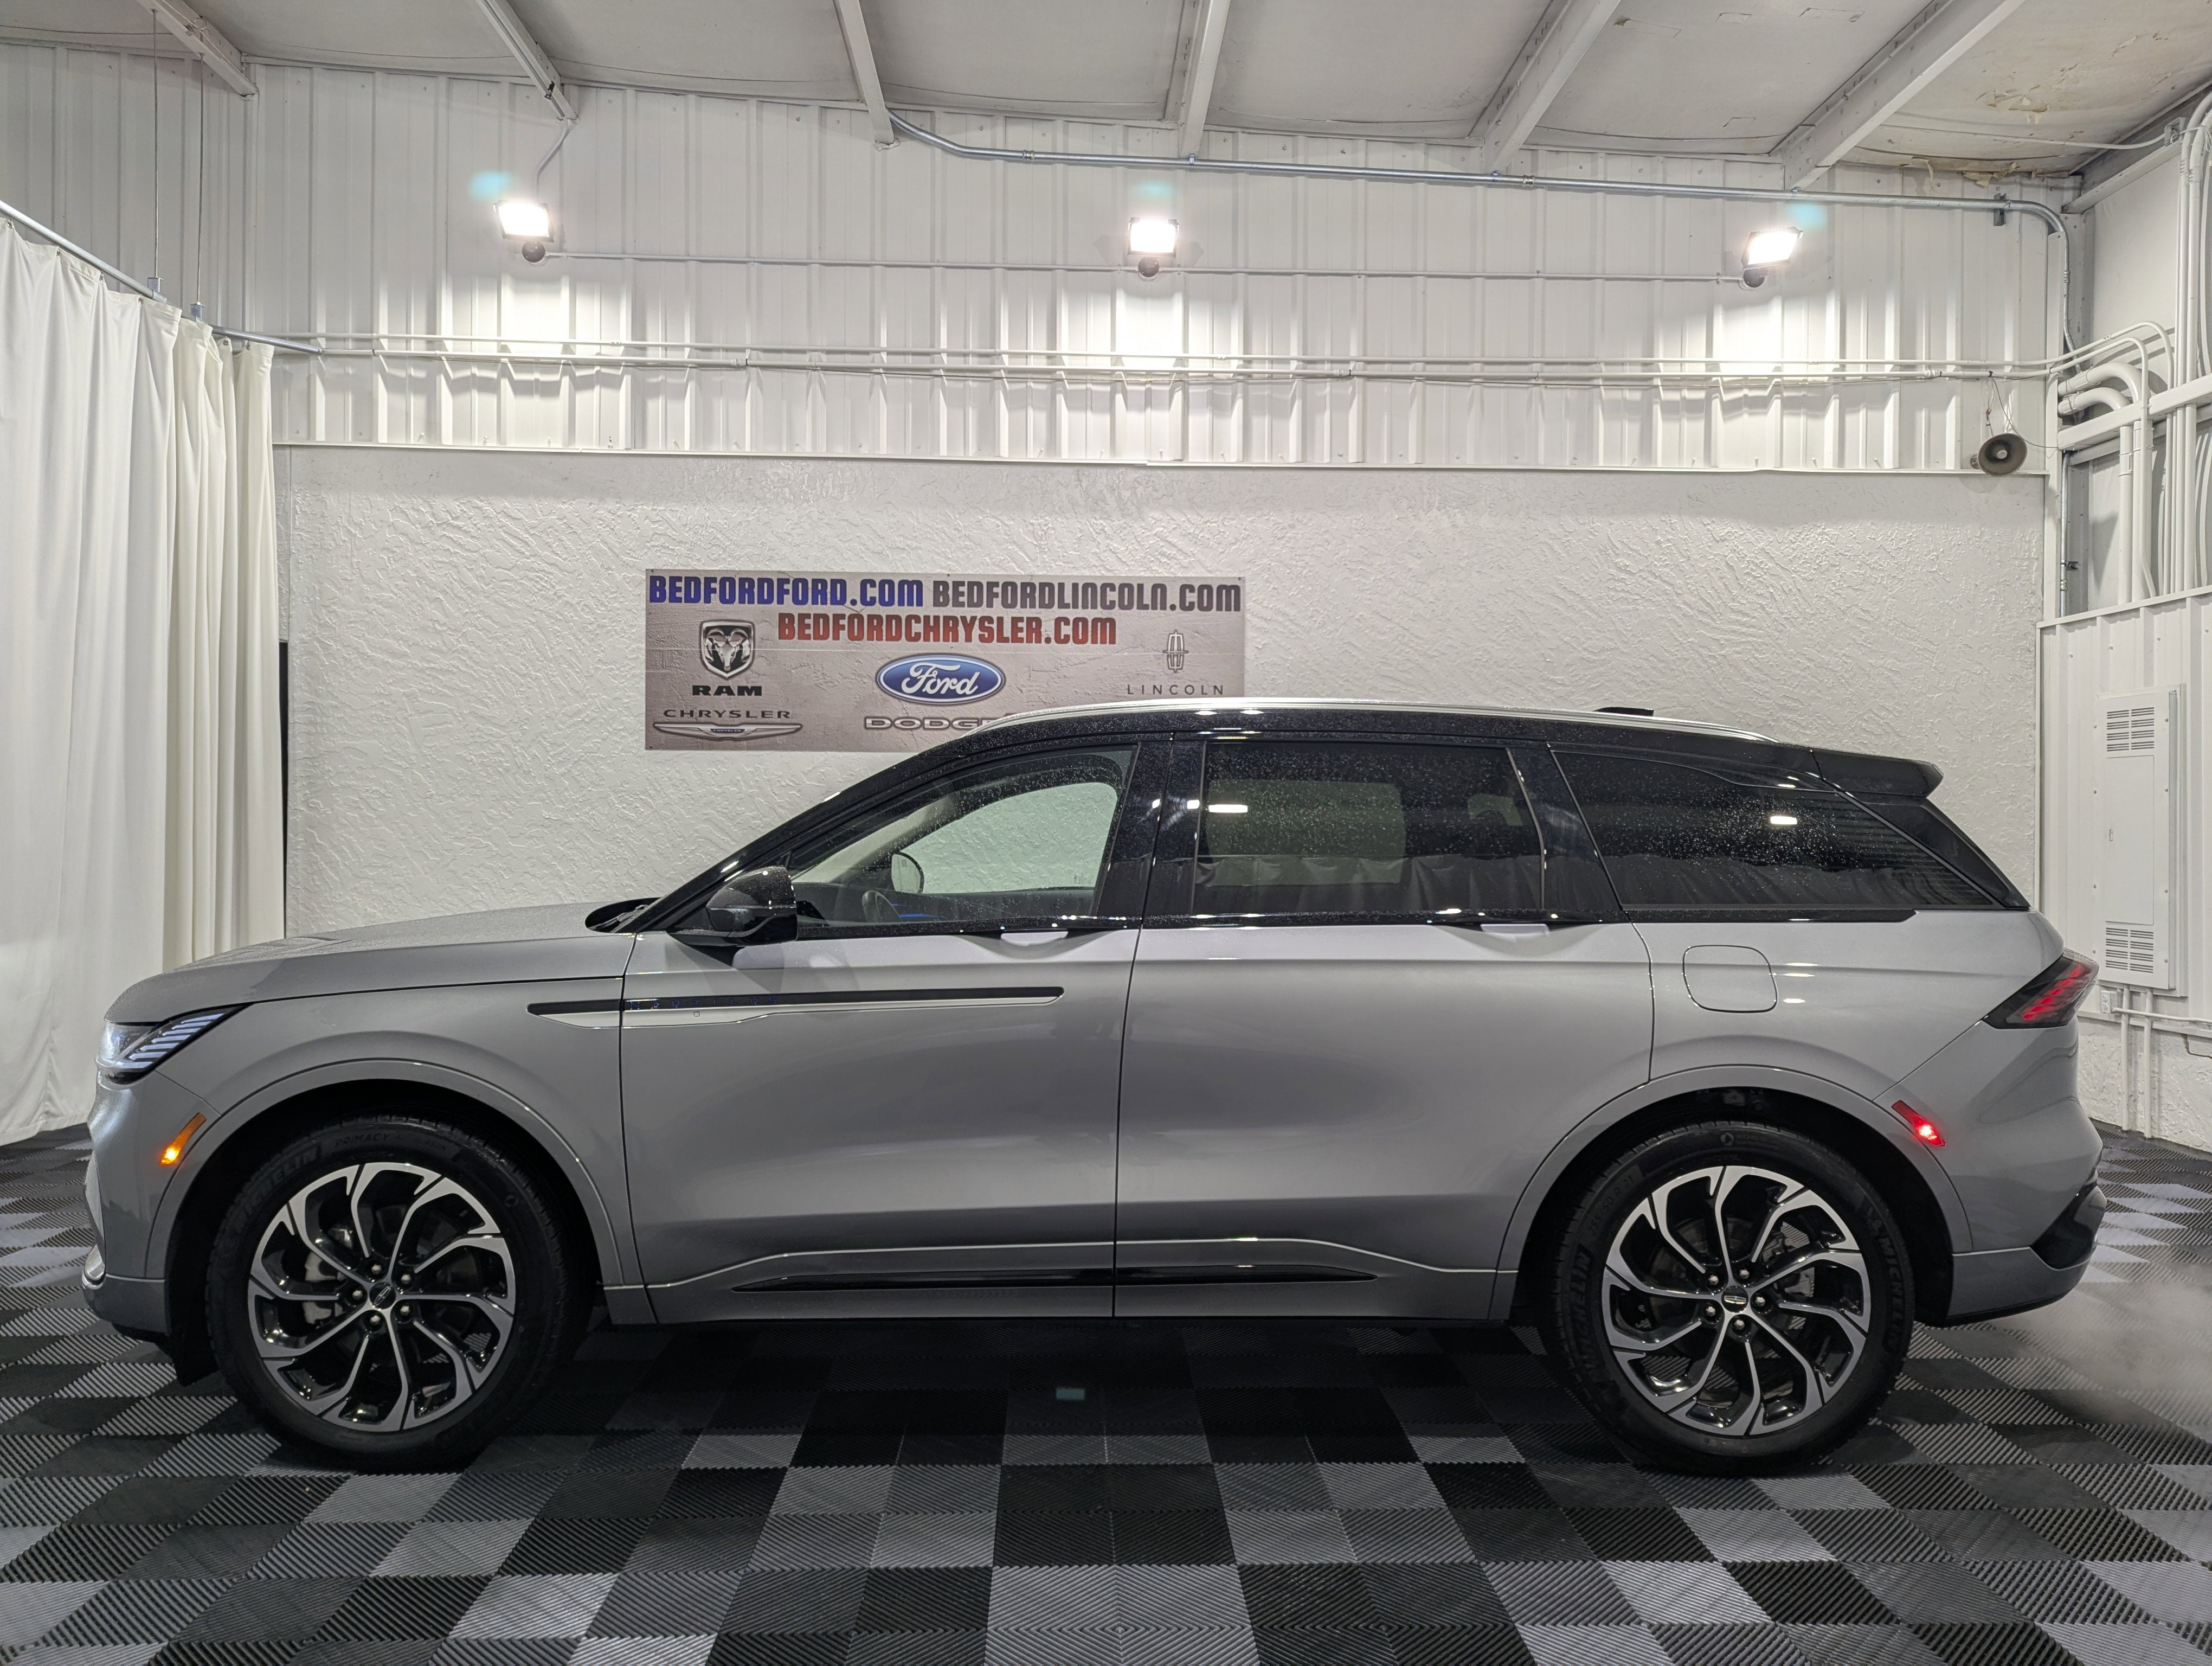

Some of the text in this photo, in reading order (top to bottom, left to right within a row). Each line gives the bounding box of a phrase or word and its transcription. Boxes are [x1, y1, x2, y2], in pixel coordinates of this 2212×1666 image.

[650, 575, 1241, 612] BEDFORDFORD.COM BEDFORDLINCOLN.COM
[778, 613, 1116, 645] BEDFORDCHRYSLER.COM
[901, 662, 979, 695] Ford
[692, 685, 762, 696] RAM
[1127, 684, 1224, 695] LINCOLN
[663, 709, 790, 719] CHRYSLER
[630, 997, 777, 1010] NAUTILUS
[335, 1133, 391, 1146] PRIMACY
